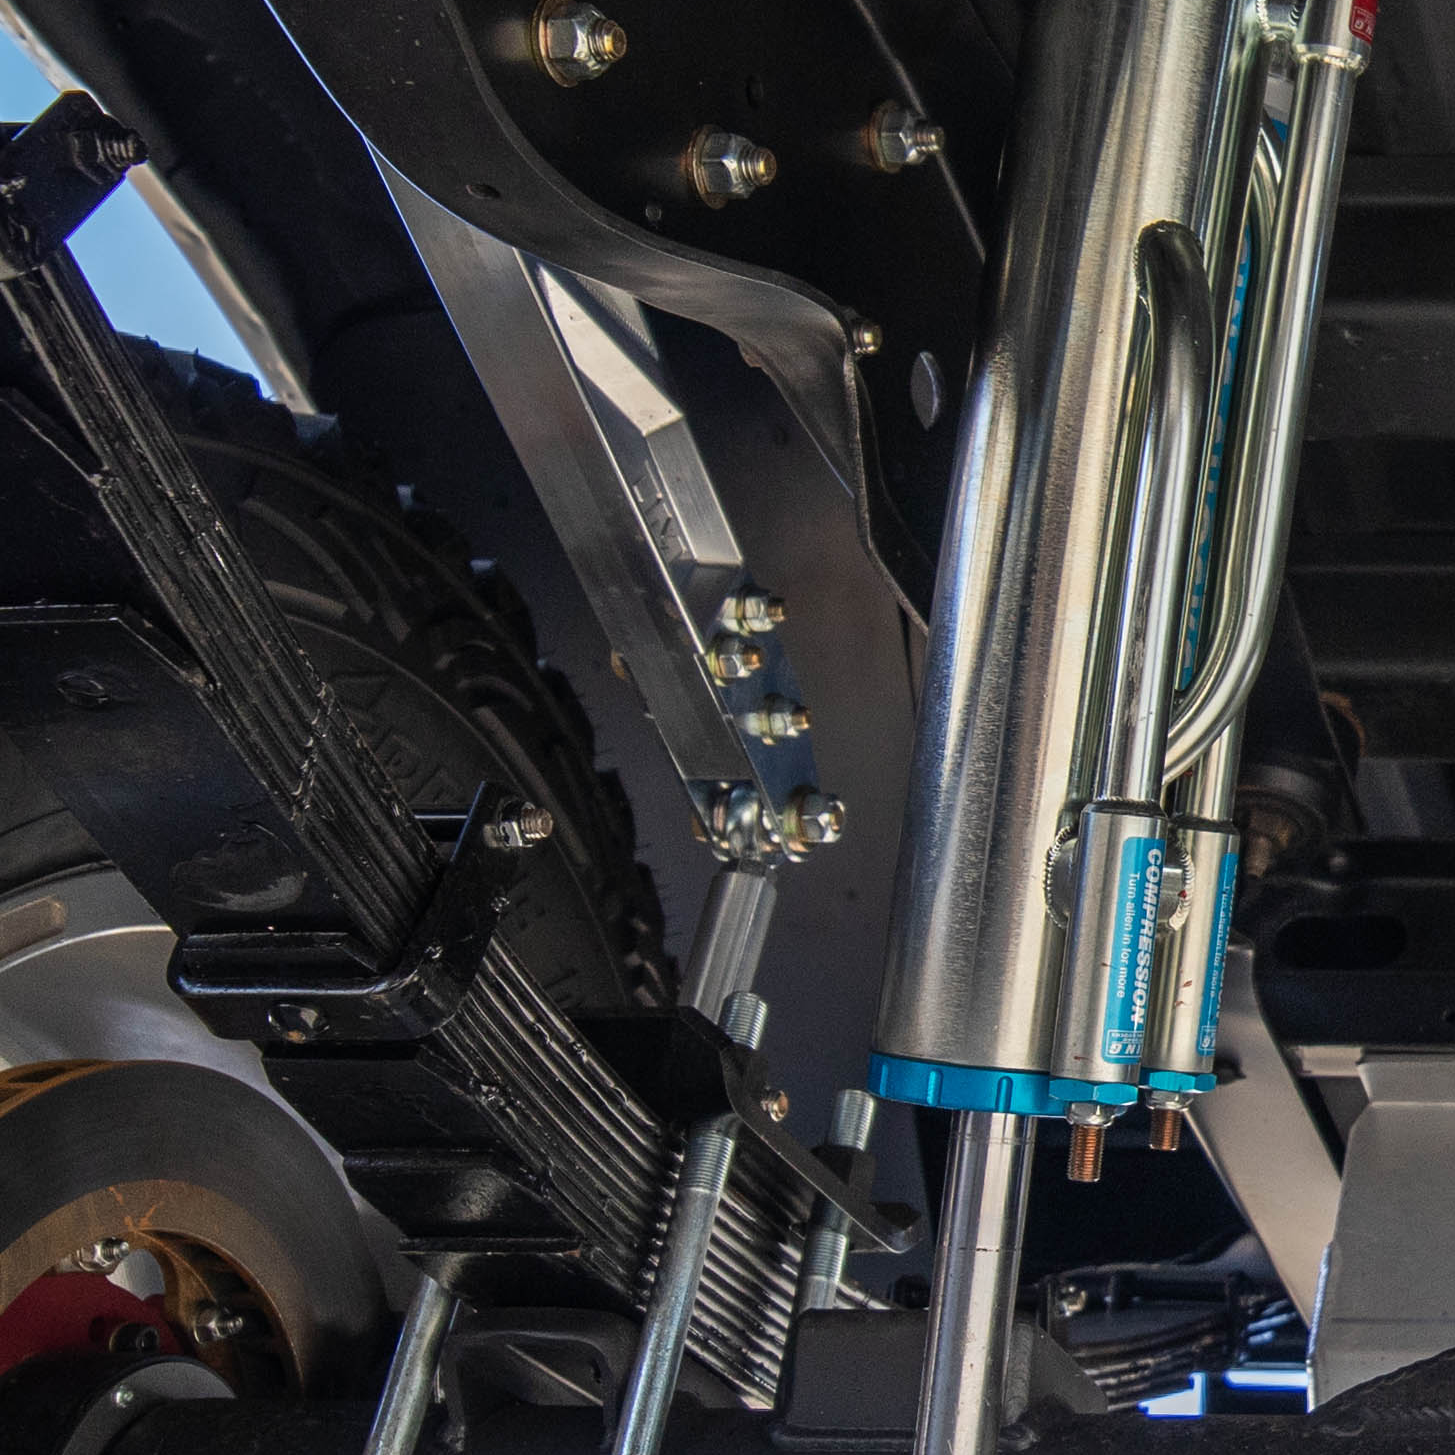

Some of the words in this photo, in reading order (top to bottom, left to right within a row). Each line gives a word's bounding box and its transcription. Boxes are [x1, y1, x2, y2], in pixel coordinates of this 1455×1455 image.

[1127, 872, 1140, 899] Turn
[1123, 901, 1136, 931] allen
[1121, 933, 1133, 945] in
[1131, 848, 1162, 1024] COMPRESSION
[1120, 948, 1132, 964] for
[1116, 967, 1128, 998] more
